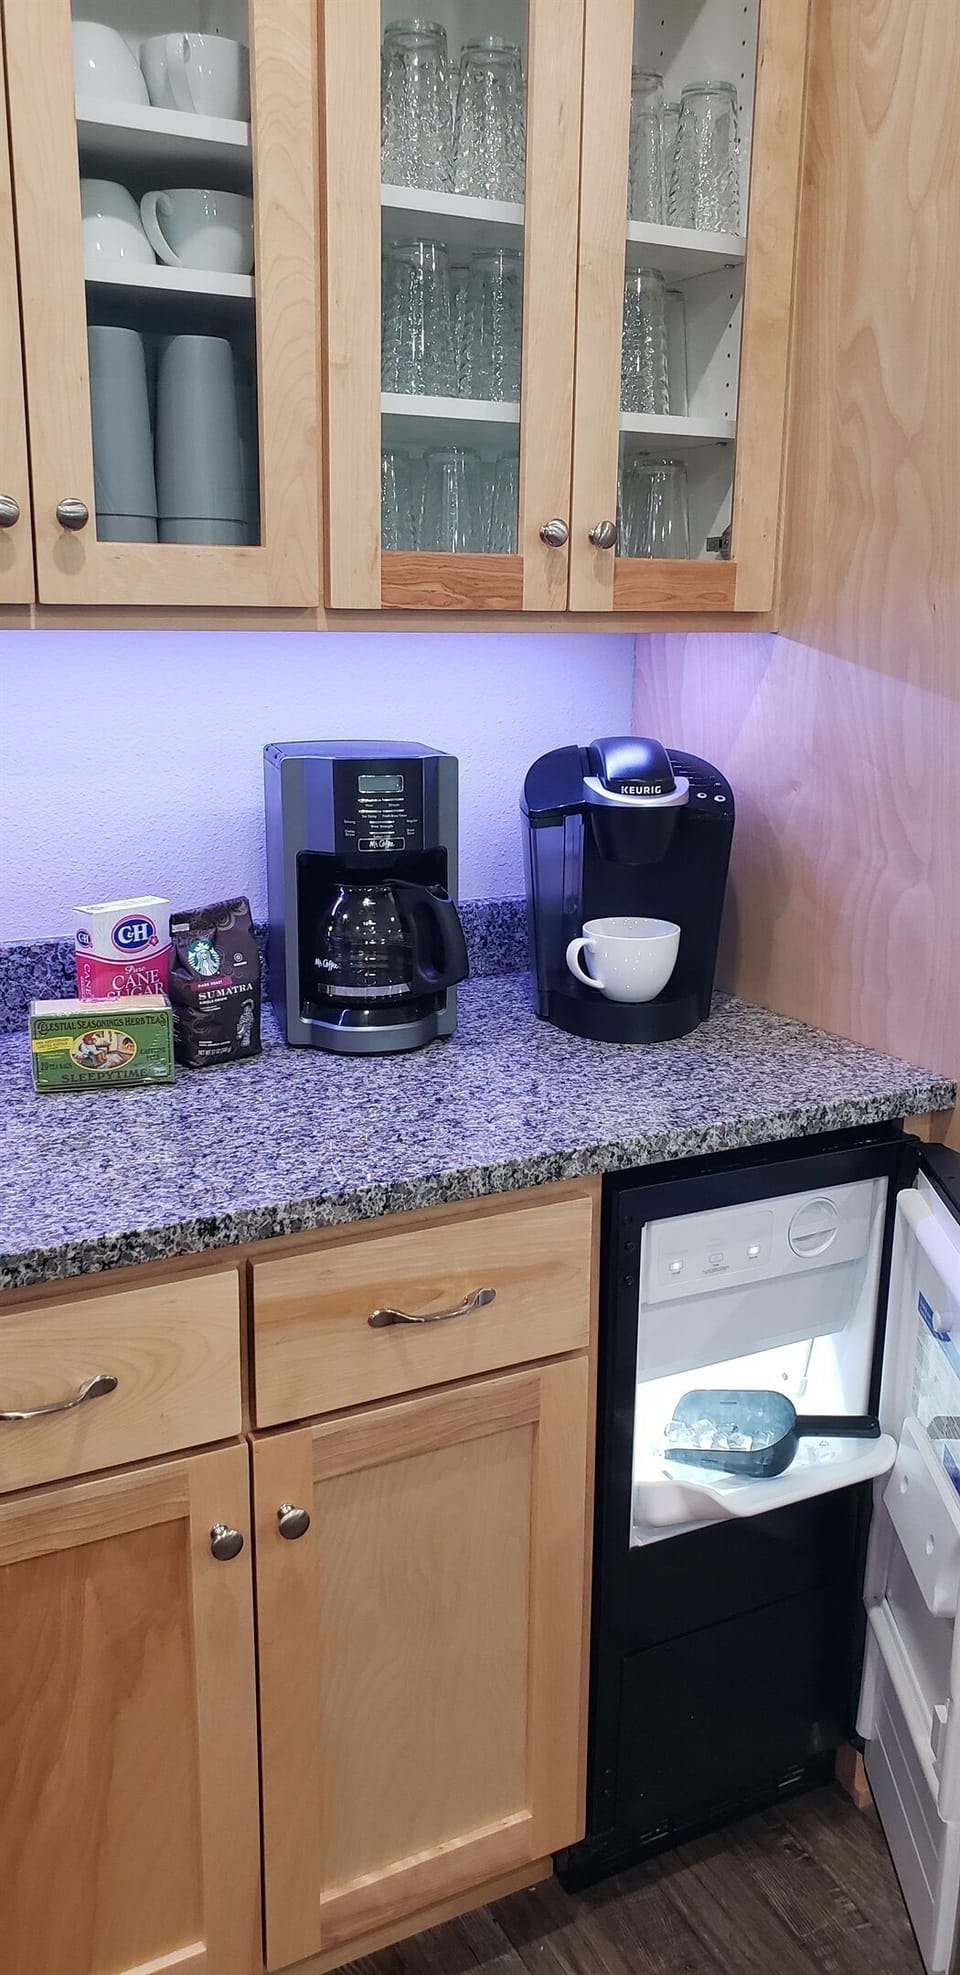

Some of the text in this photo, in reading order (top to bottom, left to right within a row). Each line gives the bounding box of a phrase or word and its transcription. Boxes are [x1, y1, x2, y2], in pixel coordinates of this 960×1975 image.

[620, 785, 662, 795] KEURIG
[112, 968, 161, 991] CANE
[198, 982, 254, 1001] SUMATRA
[38, 1013, 167, 1035] CELESTIAL SEASONINGS HERB TEAS
[61, 1068, 148, 1083] SLEEPYTIME
